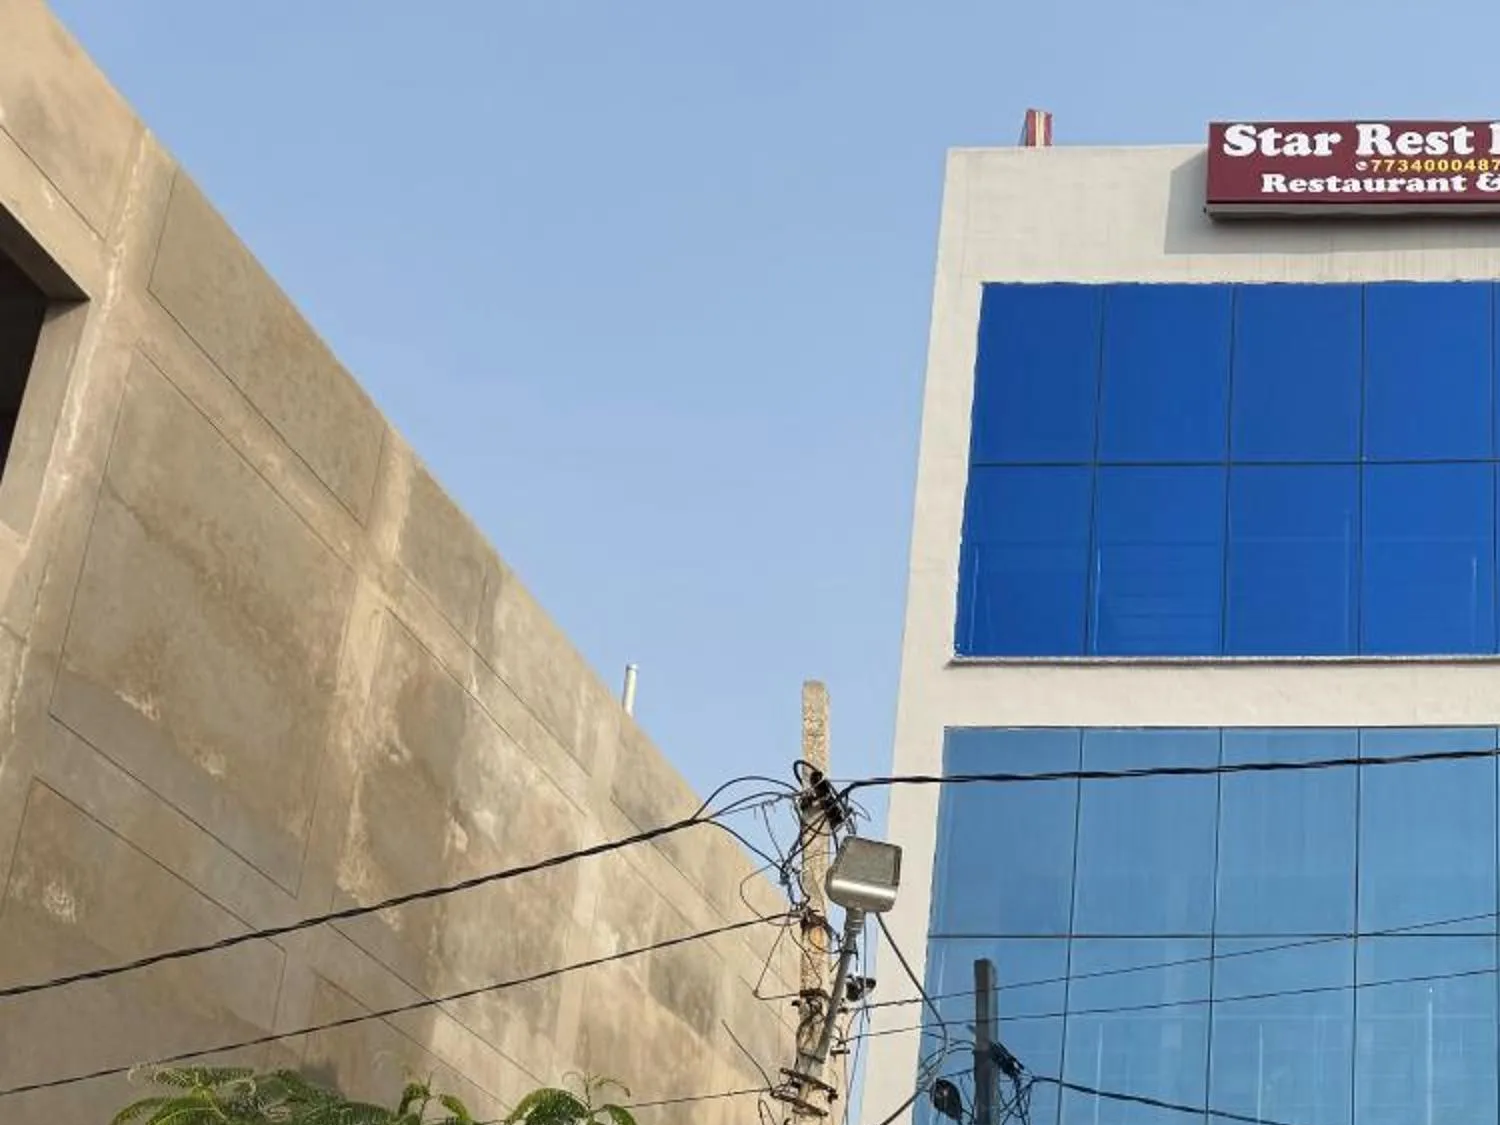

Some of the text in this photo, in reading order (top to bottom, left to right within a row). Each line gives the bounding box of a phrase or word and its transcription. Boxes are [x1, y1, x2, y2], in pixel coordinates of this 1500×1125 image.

[1223, 124, 1341, 157] Star
[1355, 123, 1475, 156] Rest
[1260, 173, 1469, 194] Restaurant
